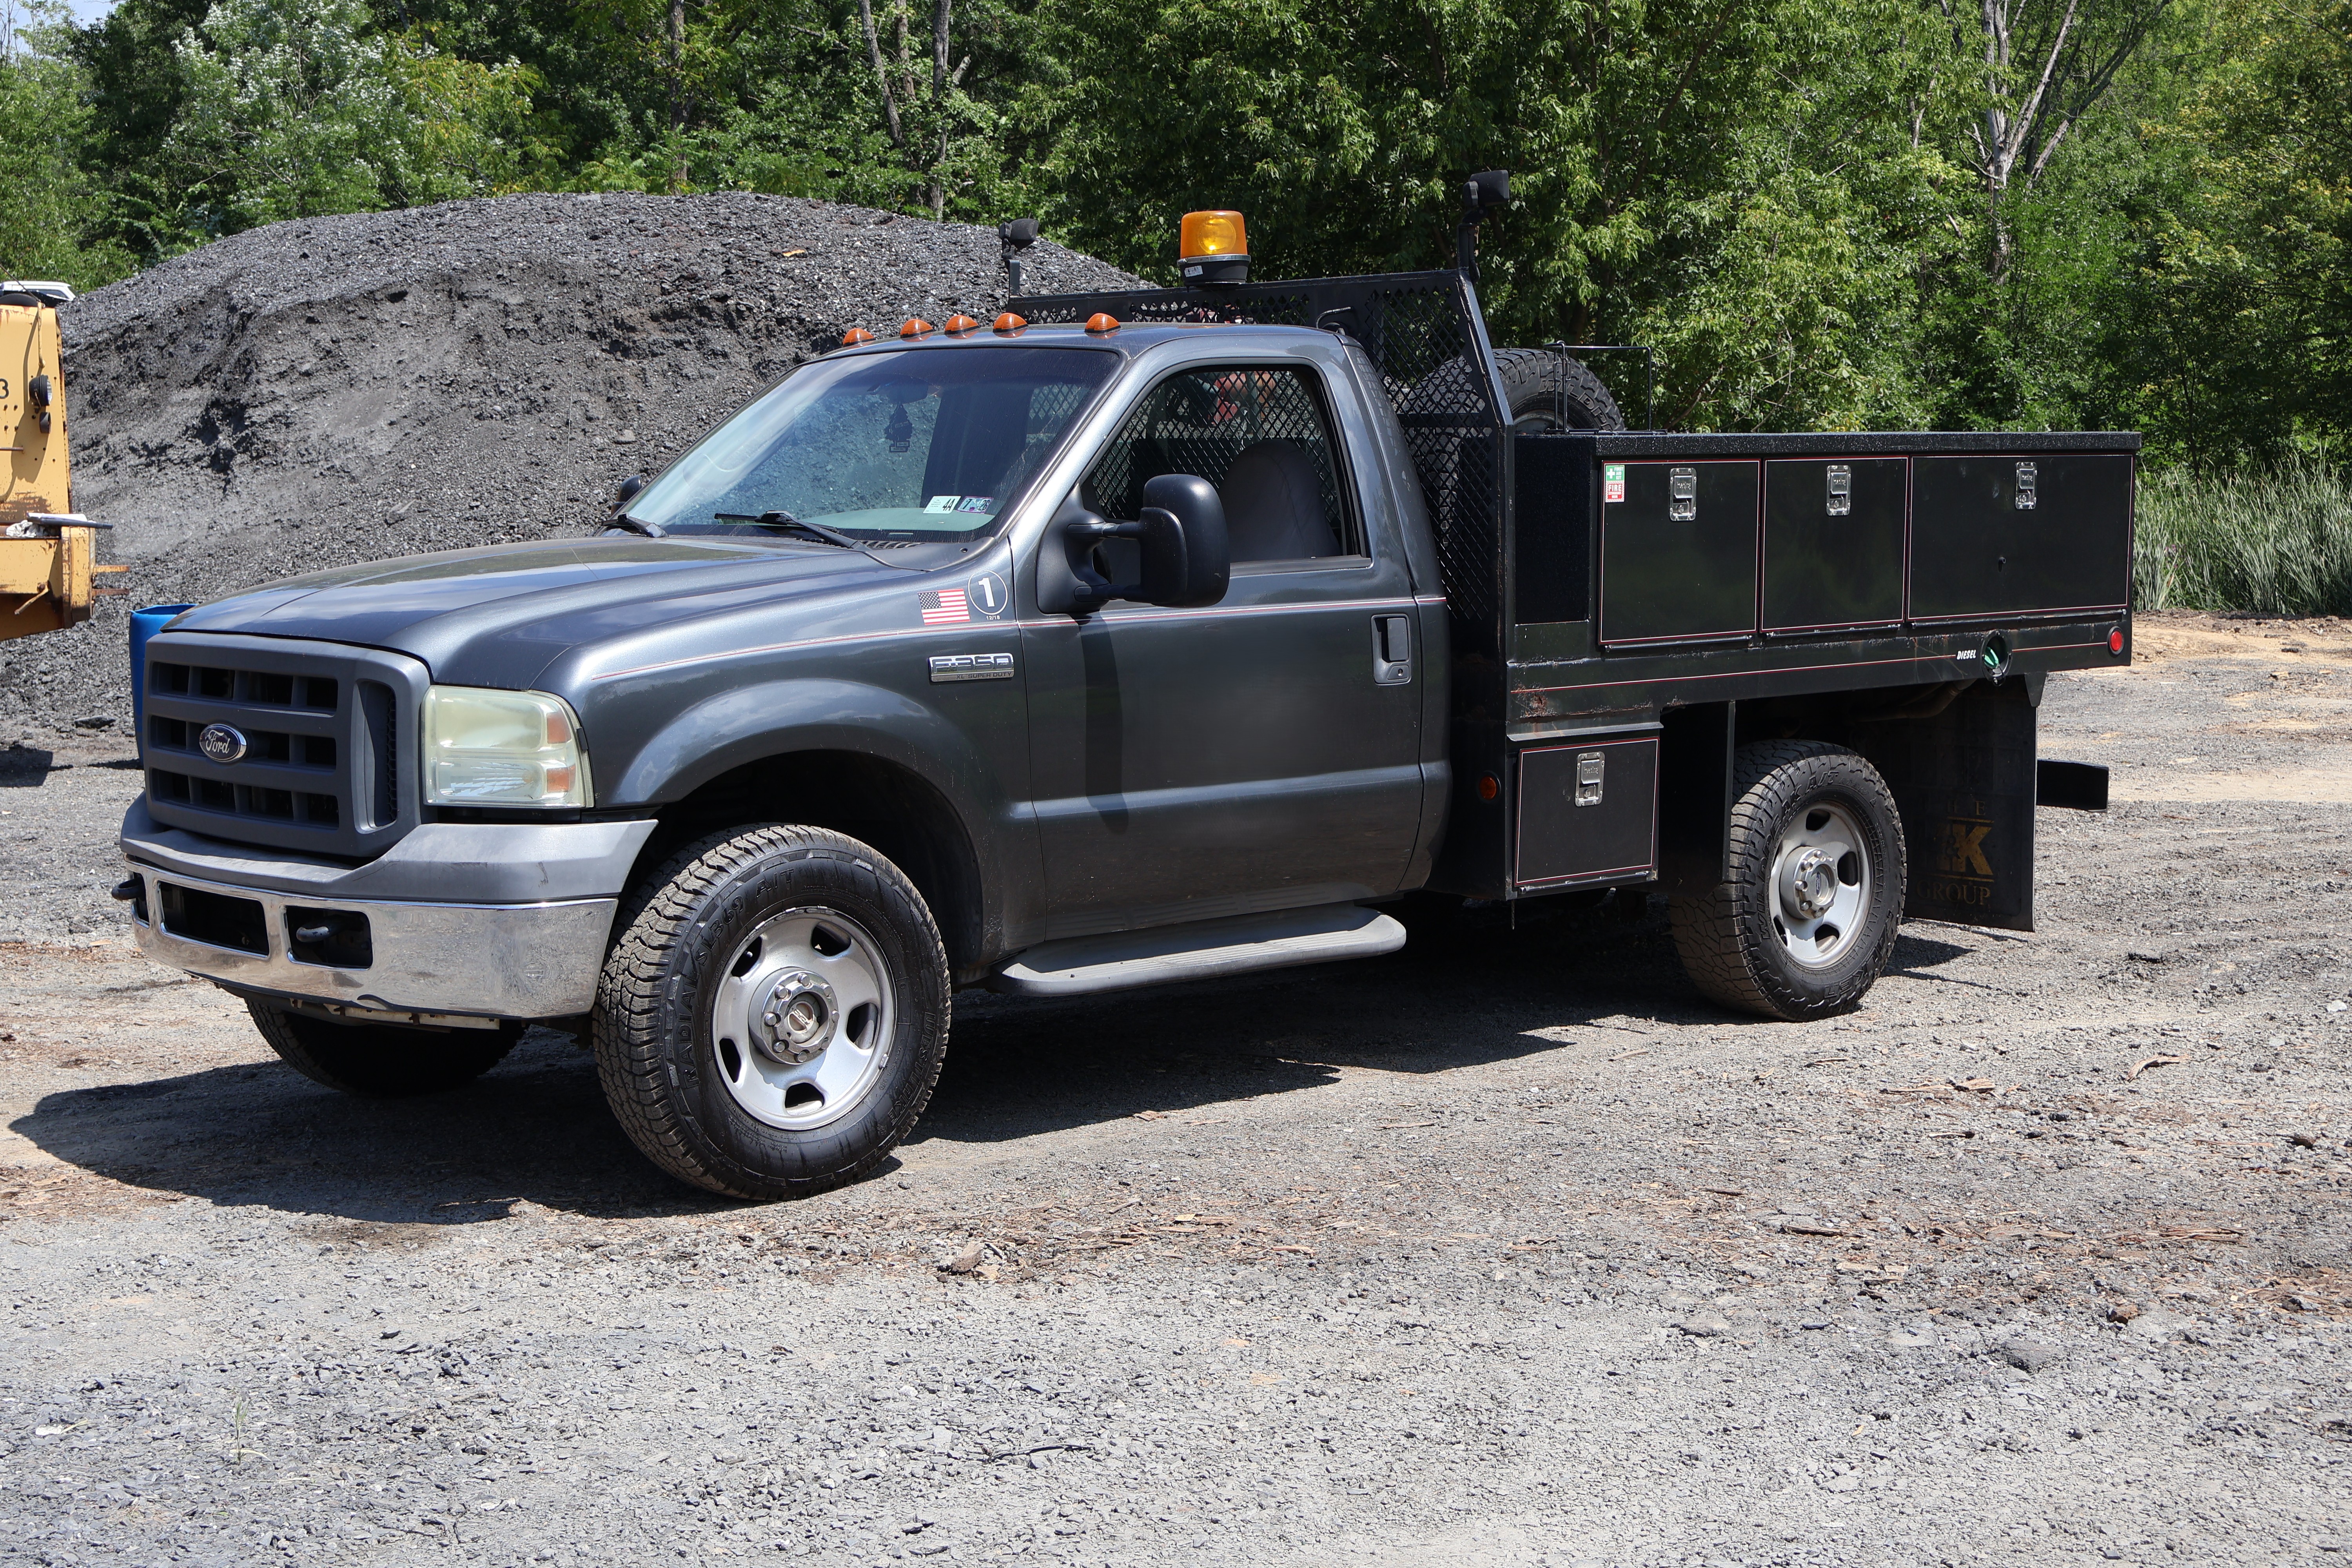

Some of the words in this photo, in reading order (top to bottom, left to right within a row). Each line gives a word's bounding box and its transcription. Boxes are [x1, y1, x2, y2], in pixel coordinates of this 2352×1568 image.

[1539, 379, 1614, 430] WILDP
[942, 498, 955, 511] 4A
[978, 577, 995, 607] 1
[932, 655, 1014, 673] F-350
[1956, 650, 1976, 660] DIESEL
[205, 730, 230, 754] Ford
[1916, 879, 1991, 906] GROUP
[678, 973, 701, 1089] RADIAL
[693, 895, 744, 967] SL369
[887, 1011, 936, 1127] WESTLAKE
